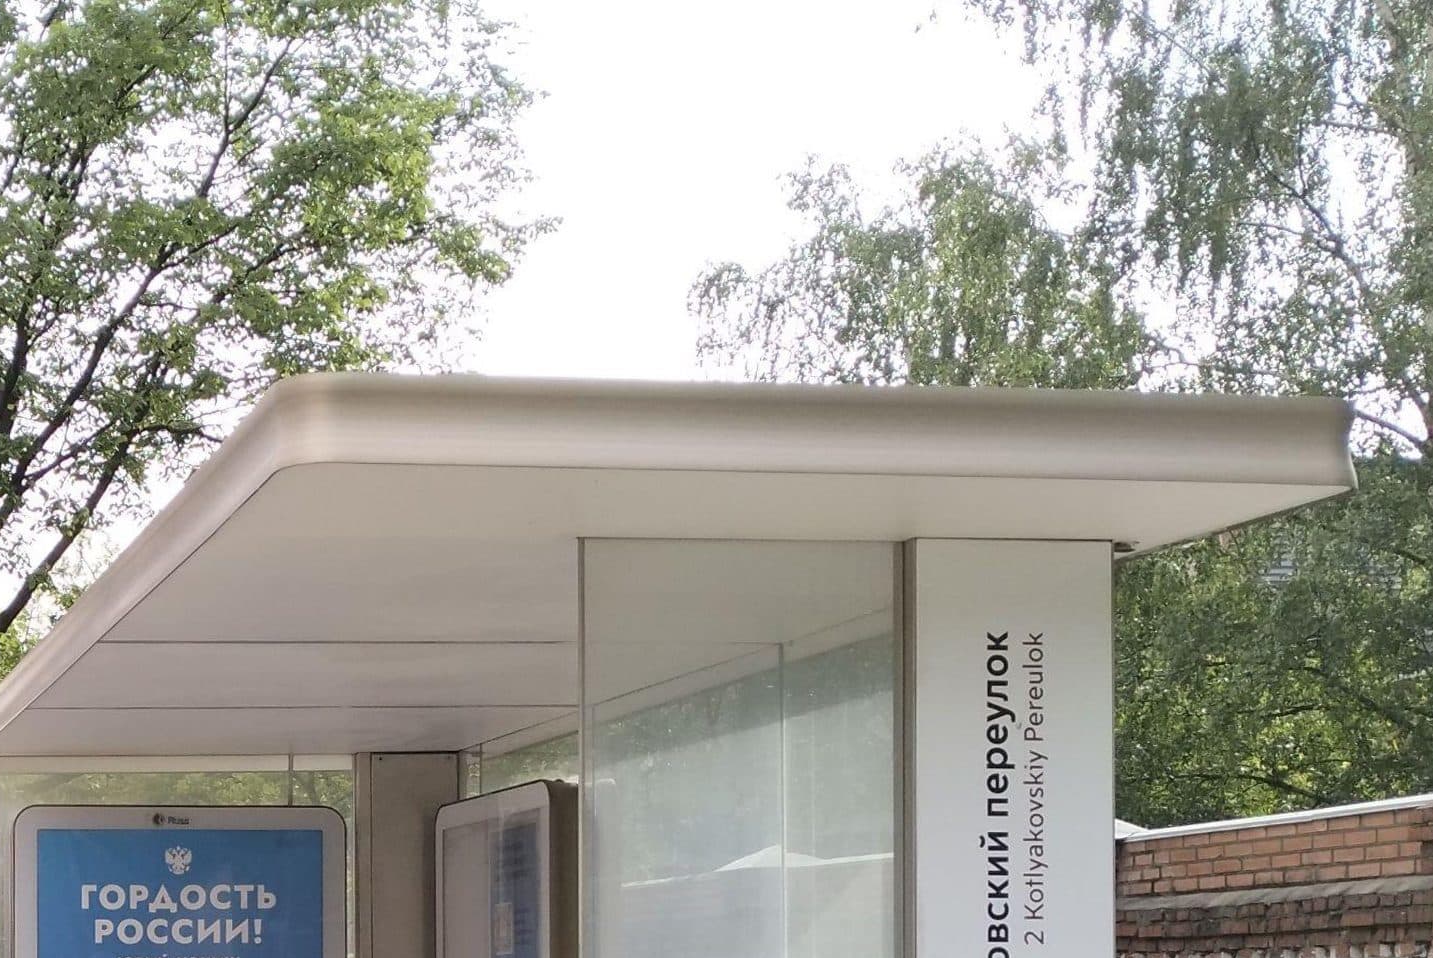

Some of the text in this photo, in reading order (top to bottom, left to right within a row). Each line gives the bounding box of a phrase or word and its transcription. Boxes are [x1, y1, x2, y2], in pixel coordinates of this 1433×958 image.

[984, 631, 1016, 817] переулок
[1022, 631, 1049, 945] 2 Kotlyakovskiy Pereulok
[81, 884, 277, 912] ГОРДОСТЬ
[94, 918, 262, 944] РОССИИ!
